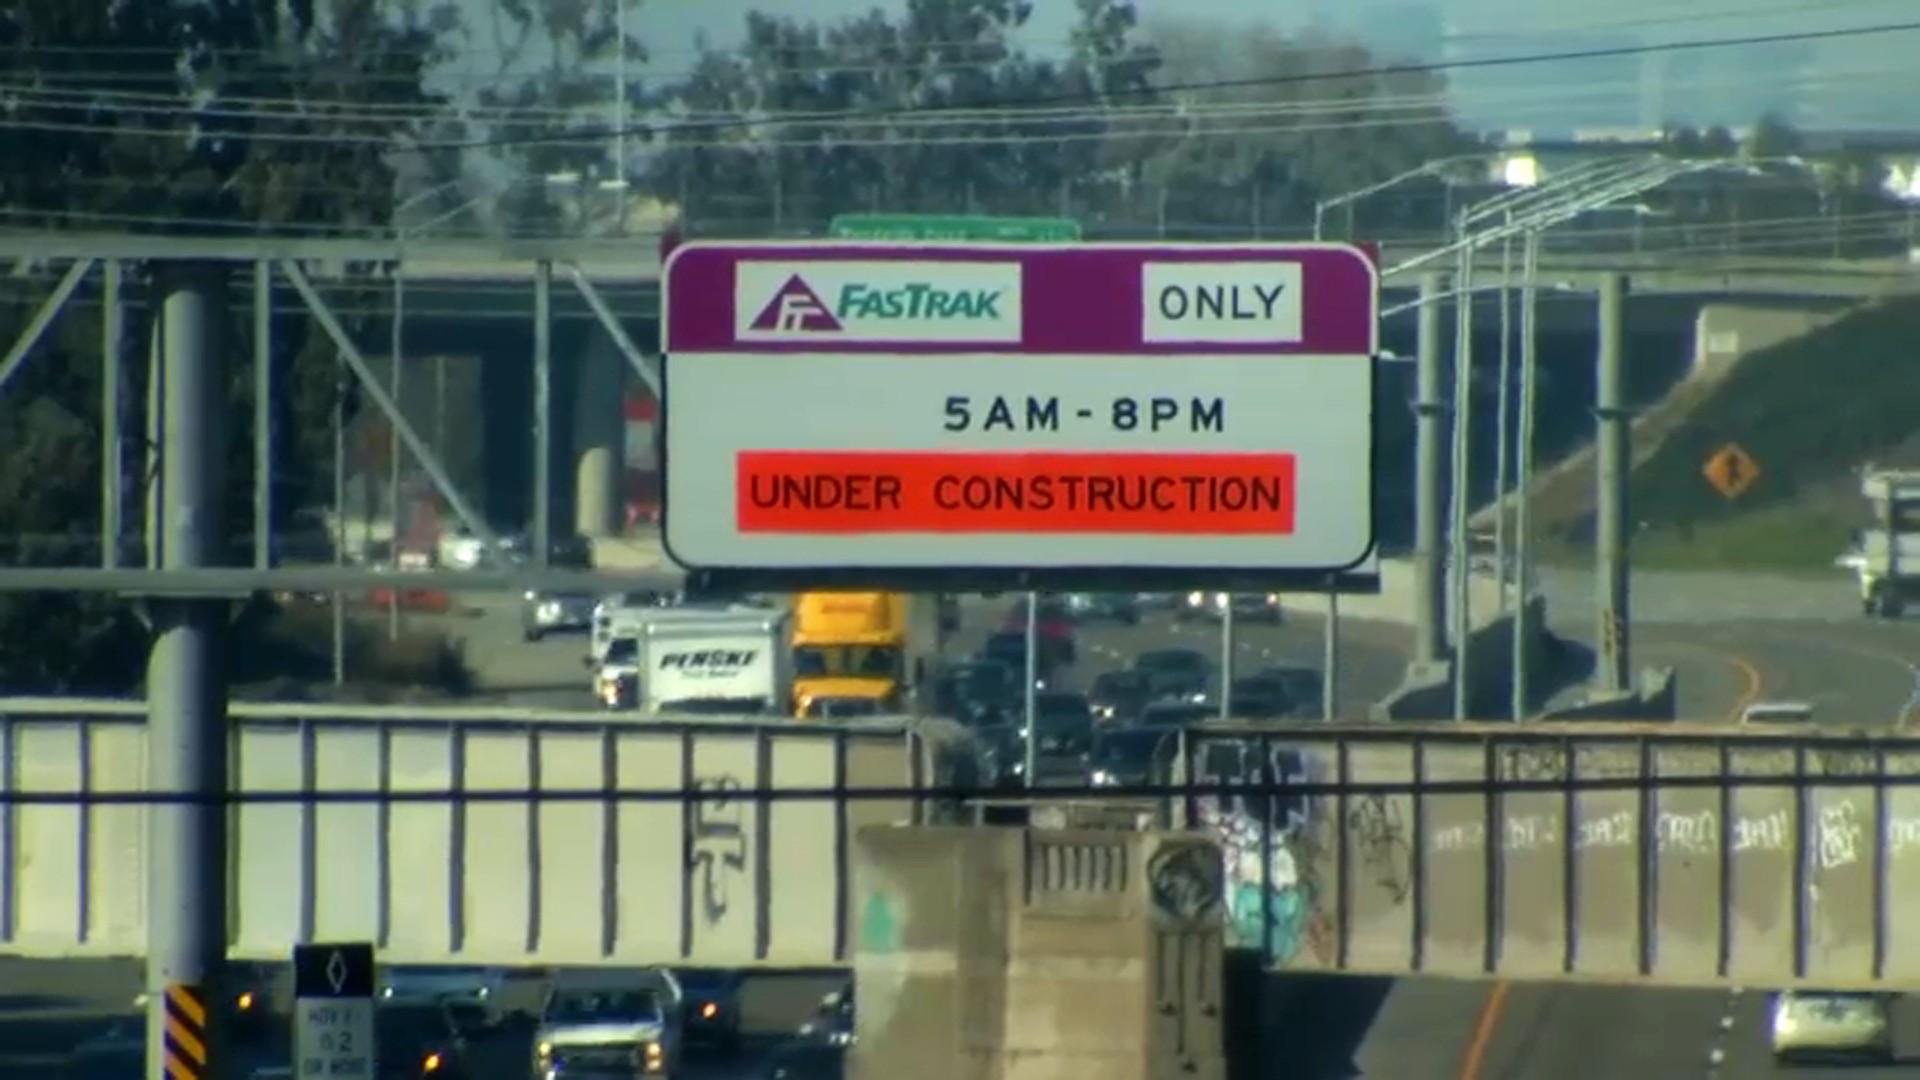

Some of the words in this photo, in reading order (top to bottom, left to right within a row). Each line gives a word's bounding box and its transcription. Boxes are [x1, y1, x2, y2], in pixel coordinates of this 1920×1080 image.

[1159, 284, 1285, 320] ONLY
[751, 474, 902, 510] UNDER
[934, 475, 1281, 512] CONSTRUCTION
